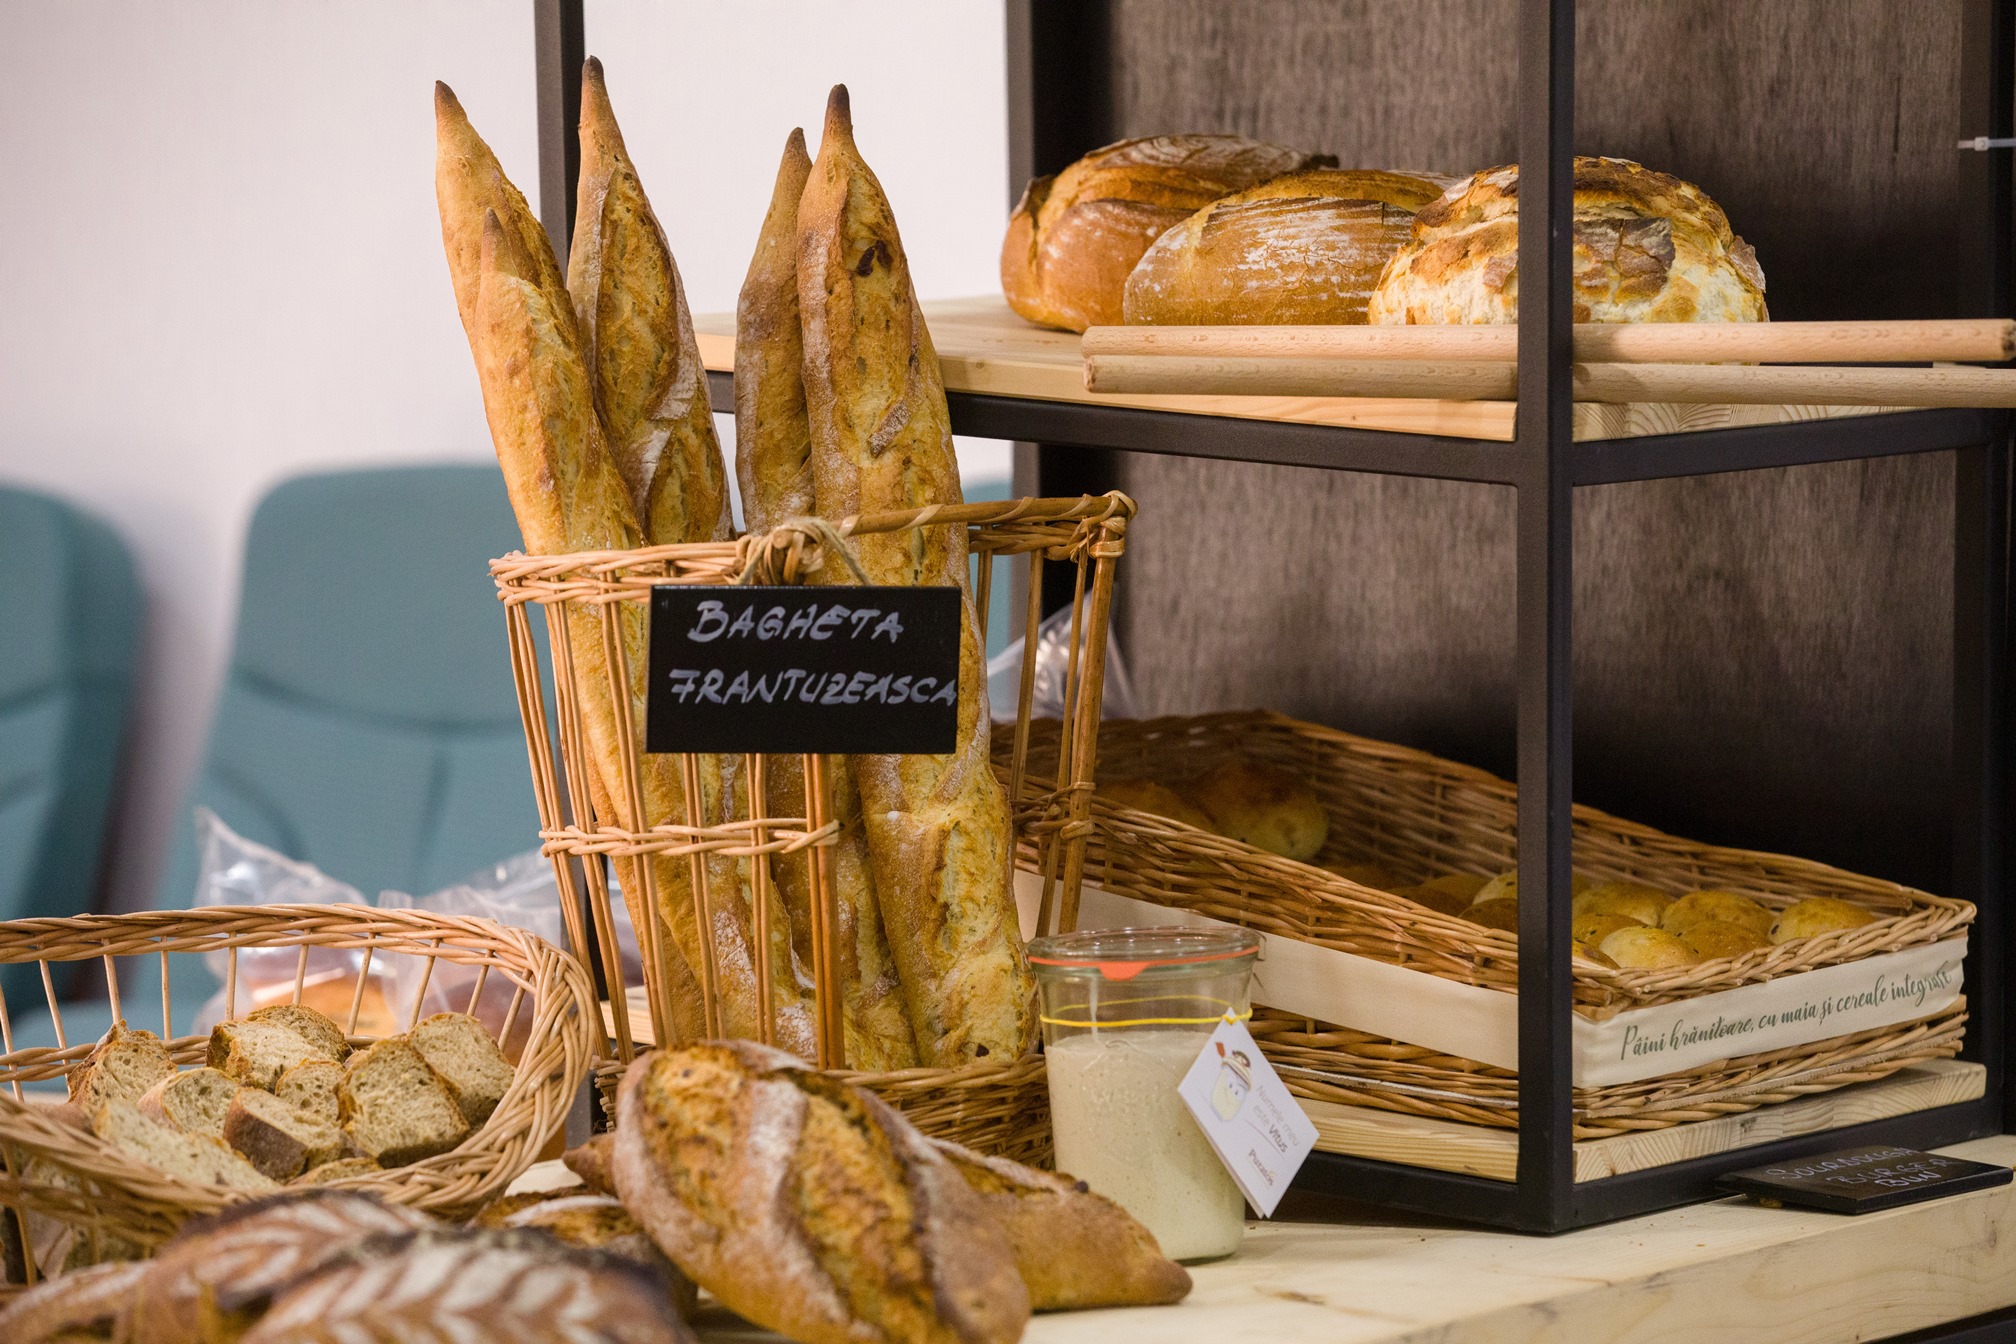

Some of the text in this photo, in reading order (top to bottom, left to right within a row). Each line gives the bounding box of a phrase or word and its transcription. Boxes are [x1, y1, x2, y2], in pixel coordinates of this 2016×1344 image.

[687, 600, 904, 643] BAGHETA
[669, 668, 957, 706] FRANTUZEASCA
[1620, 1025, 1666, 1061] Pâini
[1758, 1014, 1778, 1029] cu
[1781, 1001, 1818, 1024] maia
[1819, 996, 1833, 1026] și
[1836, 974, 1889, 1011] cereale
[1256, 1084, 1300, 1147] Numele meu
[1268, 1124, 1288, 1153] Vitus
[1766, 1147, 1917, 1180] SOURDOUGH
[1874, 1171, 1942, 1188] BUN
